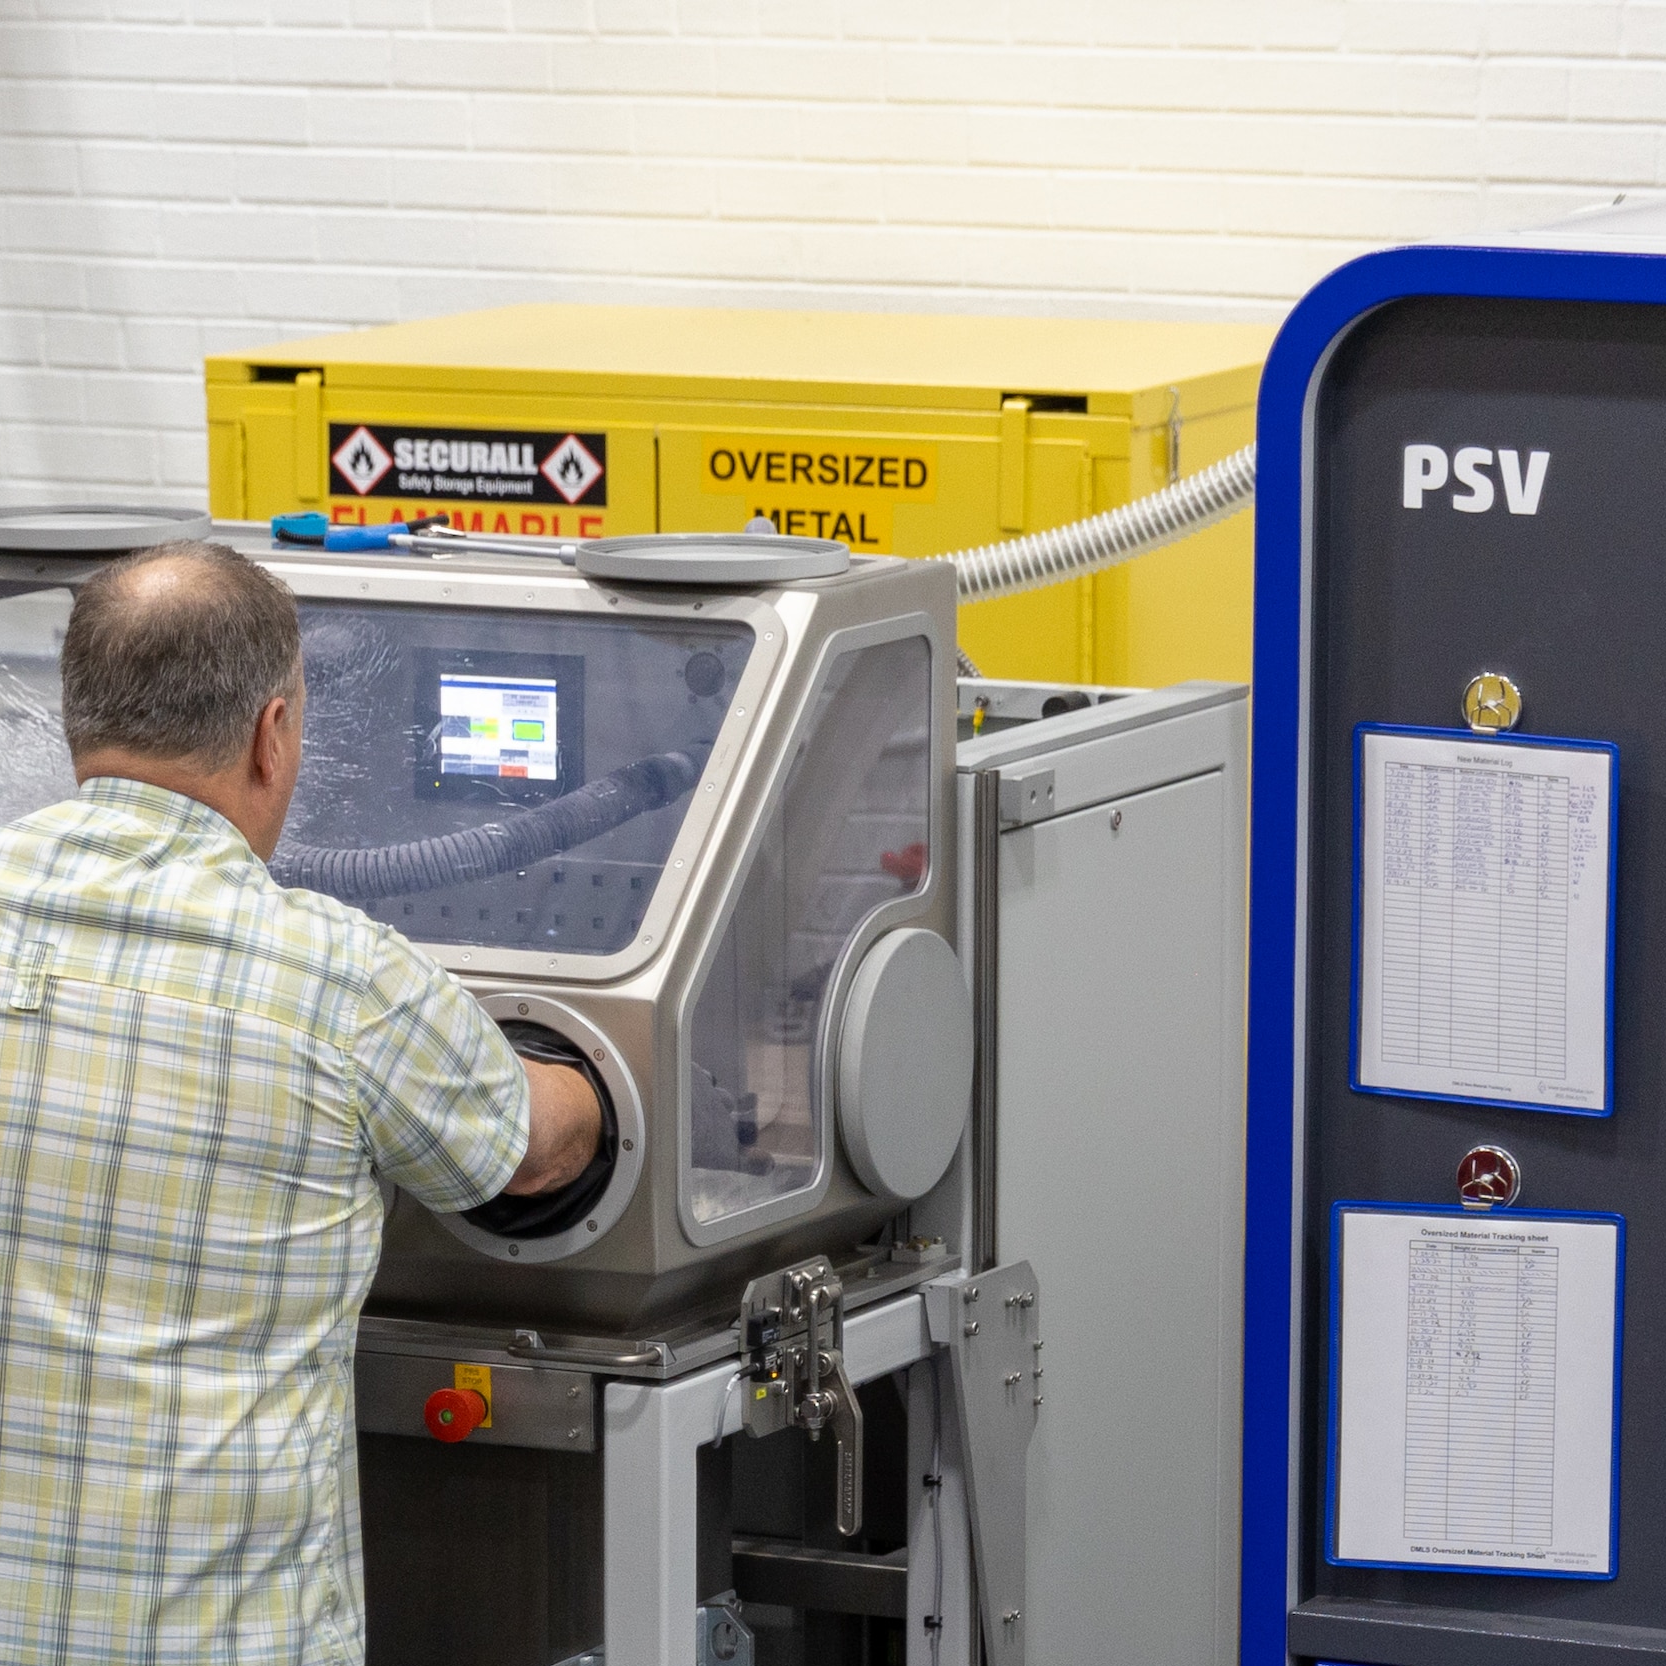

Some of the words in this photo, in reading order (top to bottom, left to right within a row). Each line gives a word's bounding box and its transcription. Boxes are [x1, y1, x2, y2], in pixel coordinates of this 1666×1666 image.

[393, 438, 538, 475] SECURALL
[710, 449, 928, 489] OVERSIZED
[399, 474, 432, 494] Safety
[434, 475, 474, 495] Storage
[476, 477, 533, 497] Equipment
[1403, 444, 1551, 515] PSV
[332, 505, 603, 538] FLAMABLE
[1457, 755, 1472, 763] New
[1473, 756, 1499, 766] Material
[1501, 759, 1513, 768] Log
[1421, 1228, 1458, 1238] Oversized
[1460, 1231, 1490, 1240] Material
[1493, 1233, 1525, 1242] Tracking
[1527, 1234, 1549, 1242] sheet
[1410, 1545, 1431, 1553] DMLS
[1432, 1547, 1466, 1555] Oversized
[1467, 1548, 1494, 1556] Material
[1495, 1550, 1525, 1559] Tracking
[1526, 1551, 1546, 1559] Sheet
